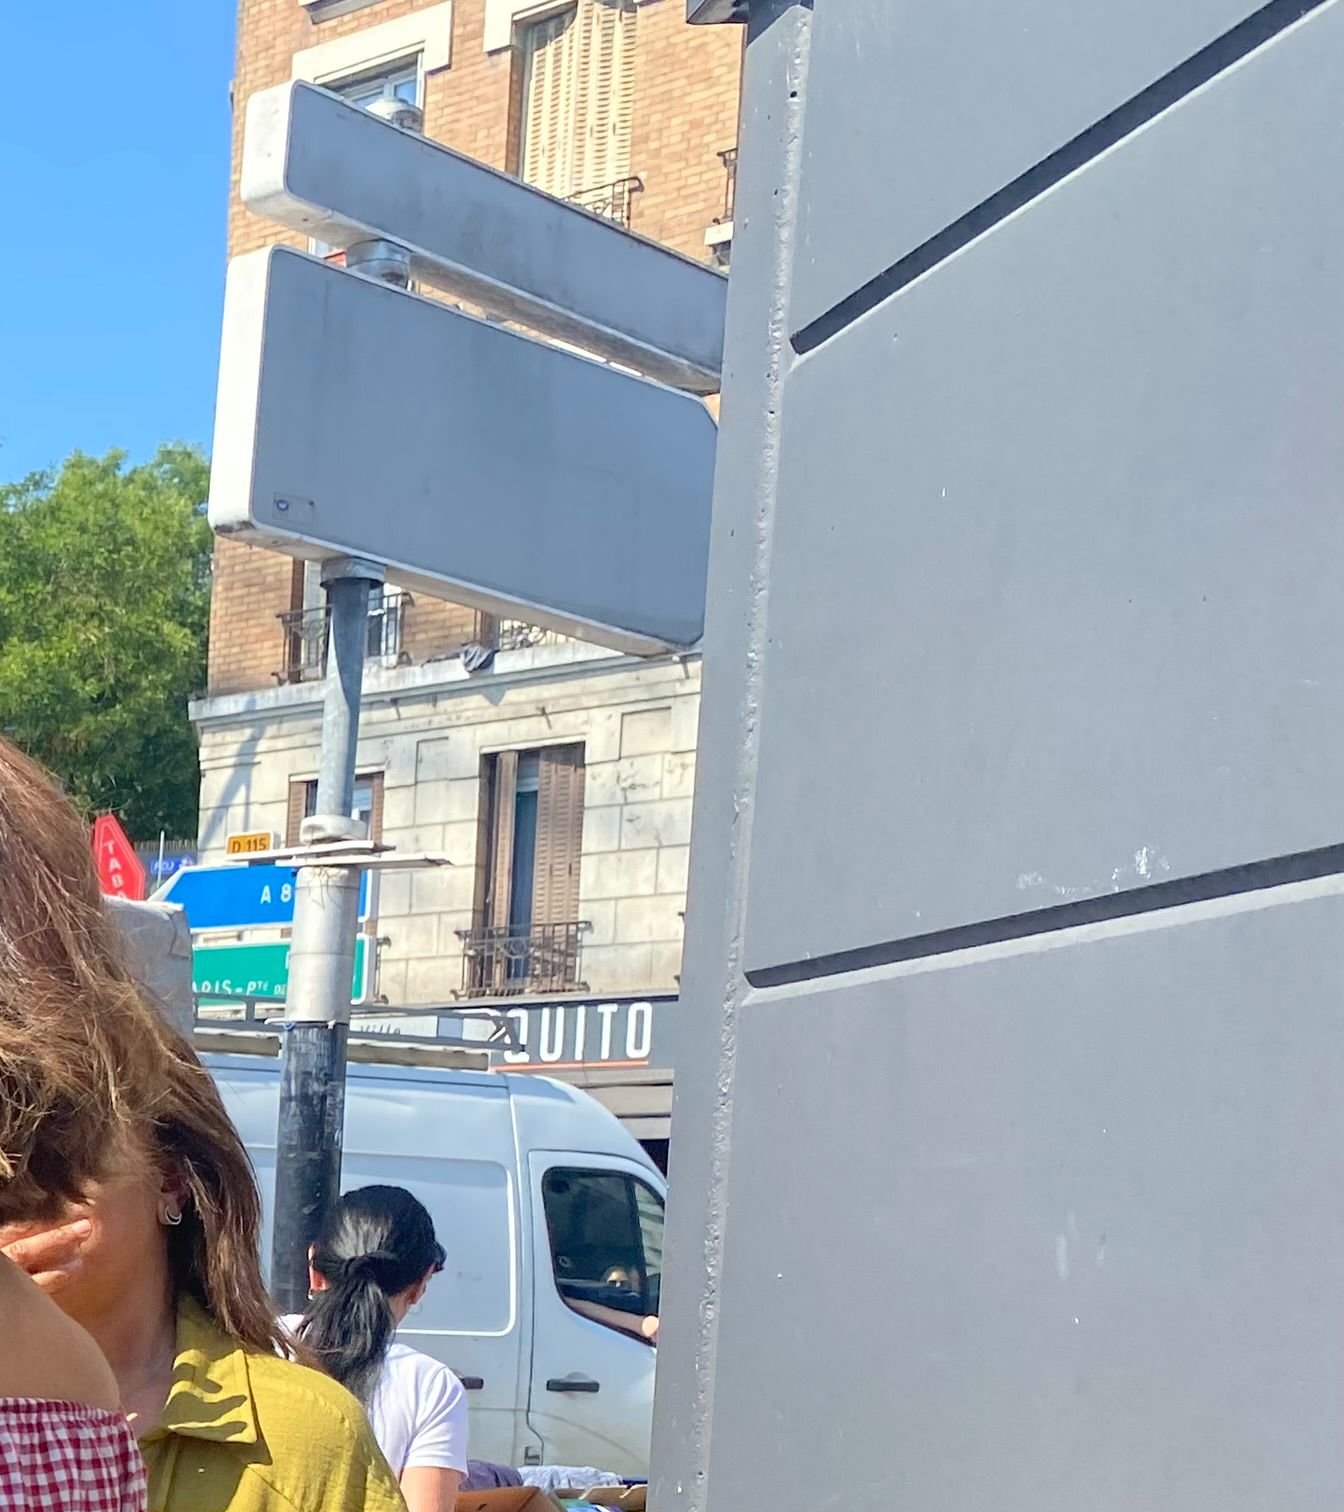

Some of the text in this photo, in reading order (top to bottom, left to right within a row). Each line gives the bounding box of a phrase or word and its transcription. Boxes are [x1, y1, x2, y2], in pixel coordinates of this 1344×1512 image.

[232, 838, 267, 852] D 115
[102, 840, 128, 900] TABA
[260, 885, 272, 904] A
